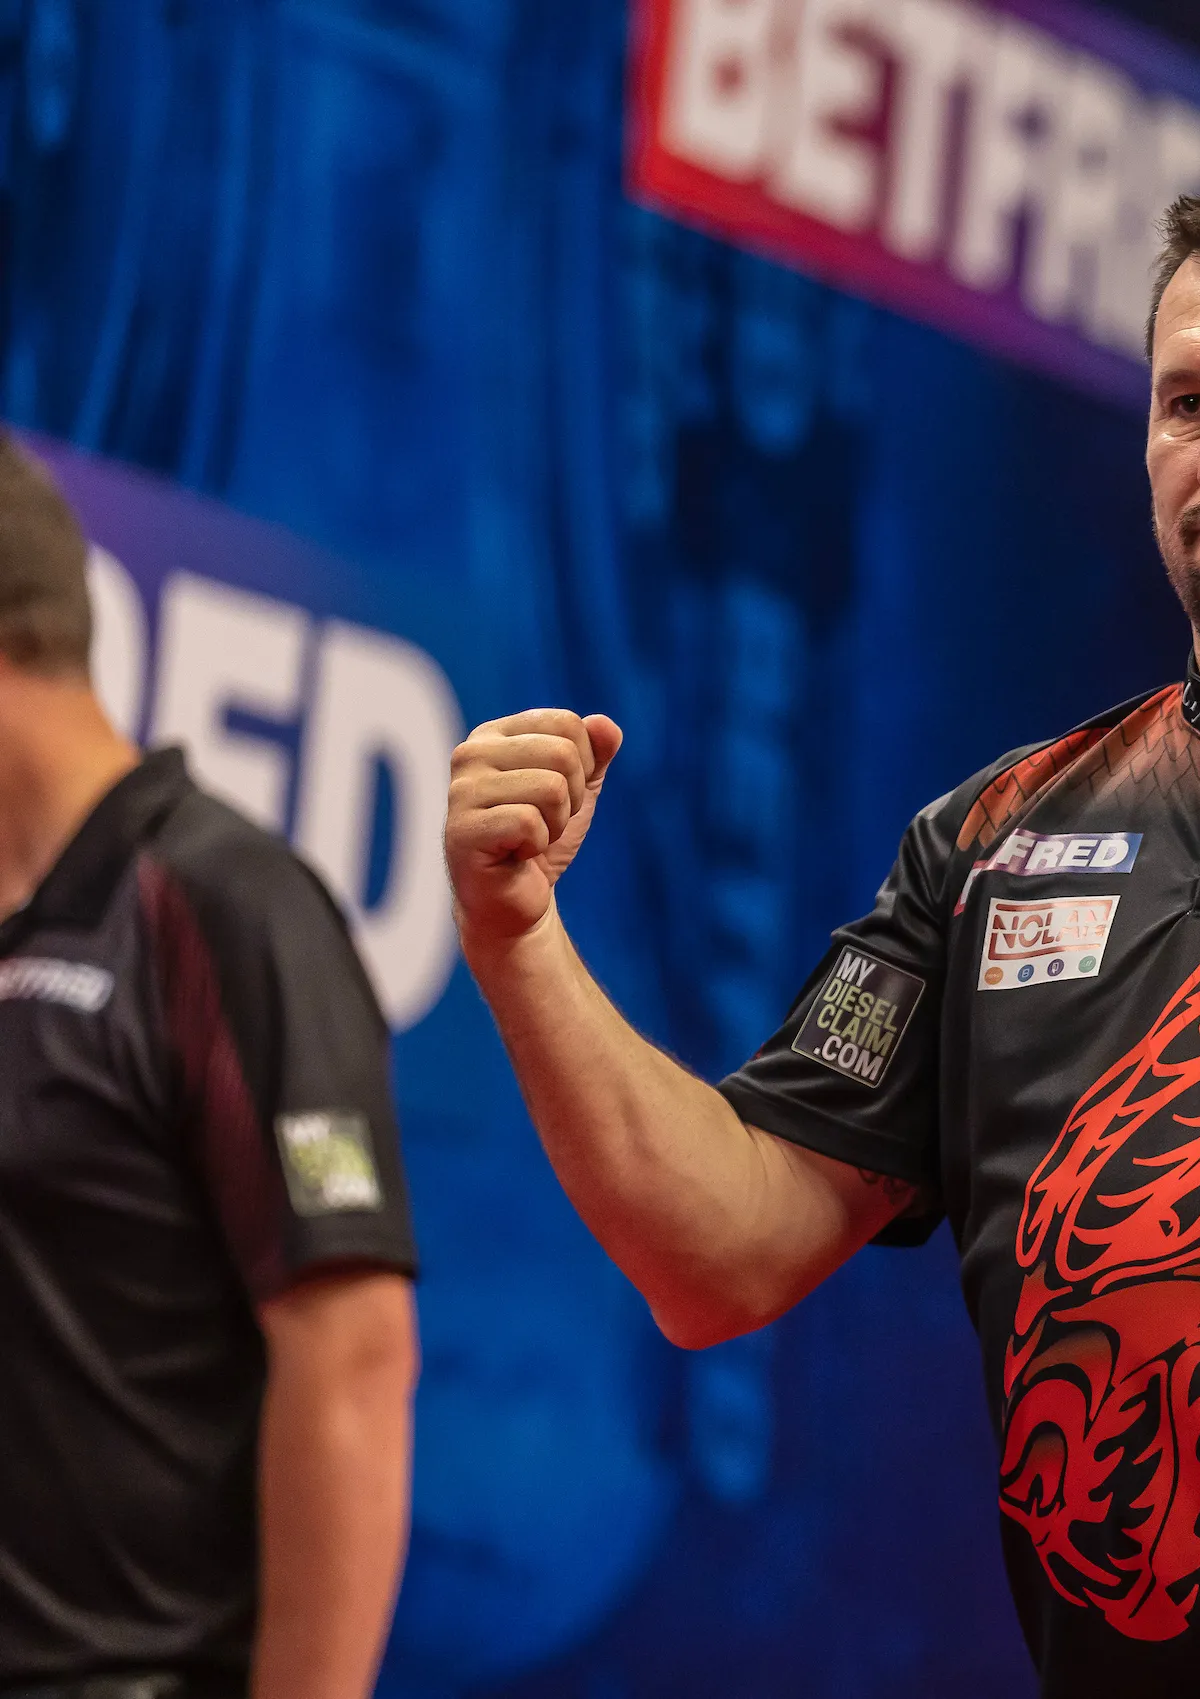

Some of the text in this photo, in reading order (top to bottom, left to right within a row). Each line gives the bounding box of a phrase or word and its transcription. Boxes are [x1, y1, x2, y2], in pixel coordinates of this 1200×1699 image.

[836, 952, 878, 987] MY
[823, 978, 898, 1033] DIESEL
[817, 1004, 895, 1057] CLAIM
[813, 1035, 884, 1081] .COM
